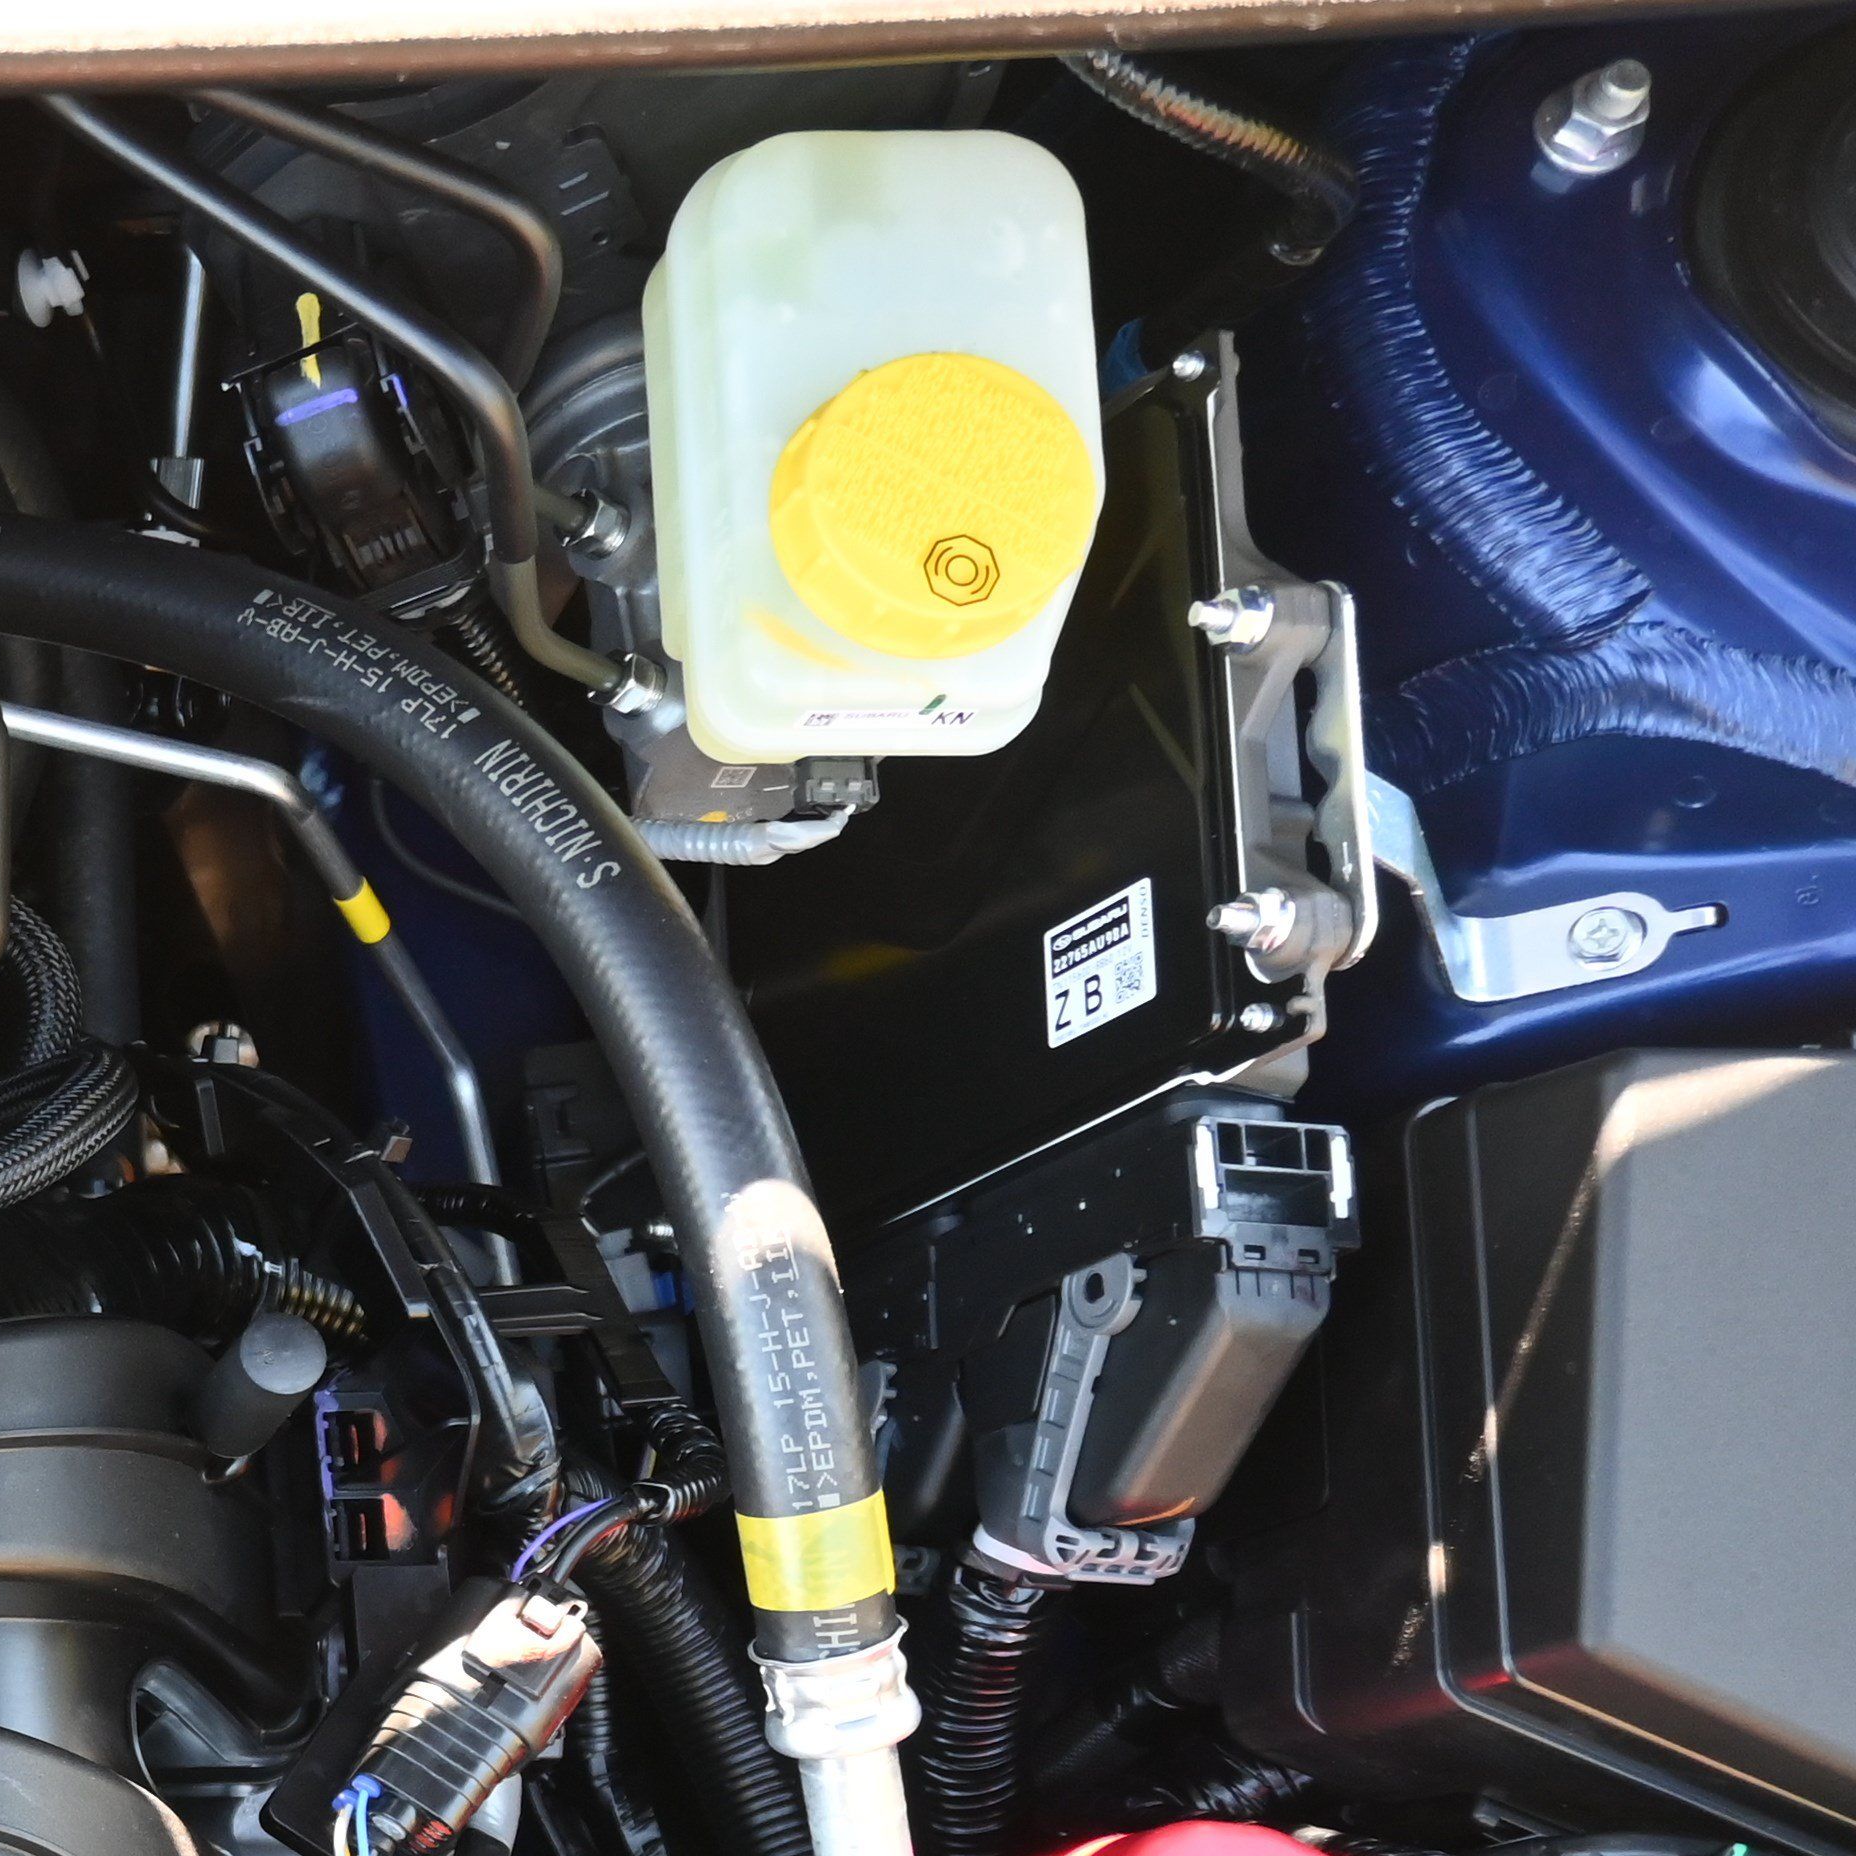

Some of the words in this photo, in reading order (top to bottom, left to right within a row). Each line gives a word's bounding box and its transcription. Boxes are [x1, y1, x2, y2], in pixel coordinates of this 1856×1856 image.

[400, 697, 460, 740] 17LP
[931, 711, 975, 725] KN
[1072, 903, 1128, 942] SUBARU
[781, 1433, 815, 1511] 17LP
